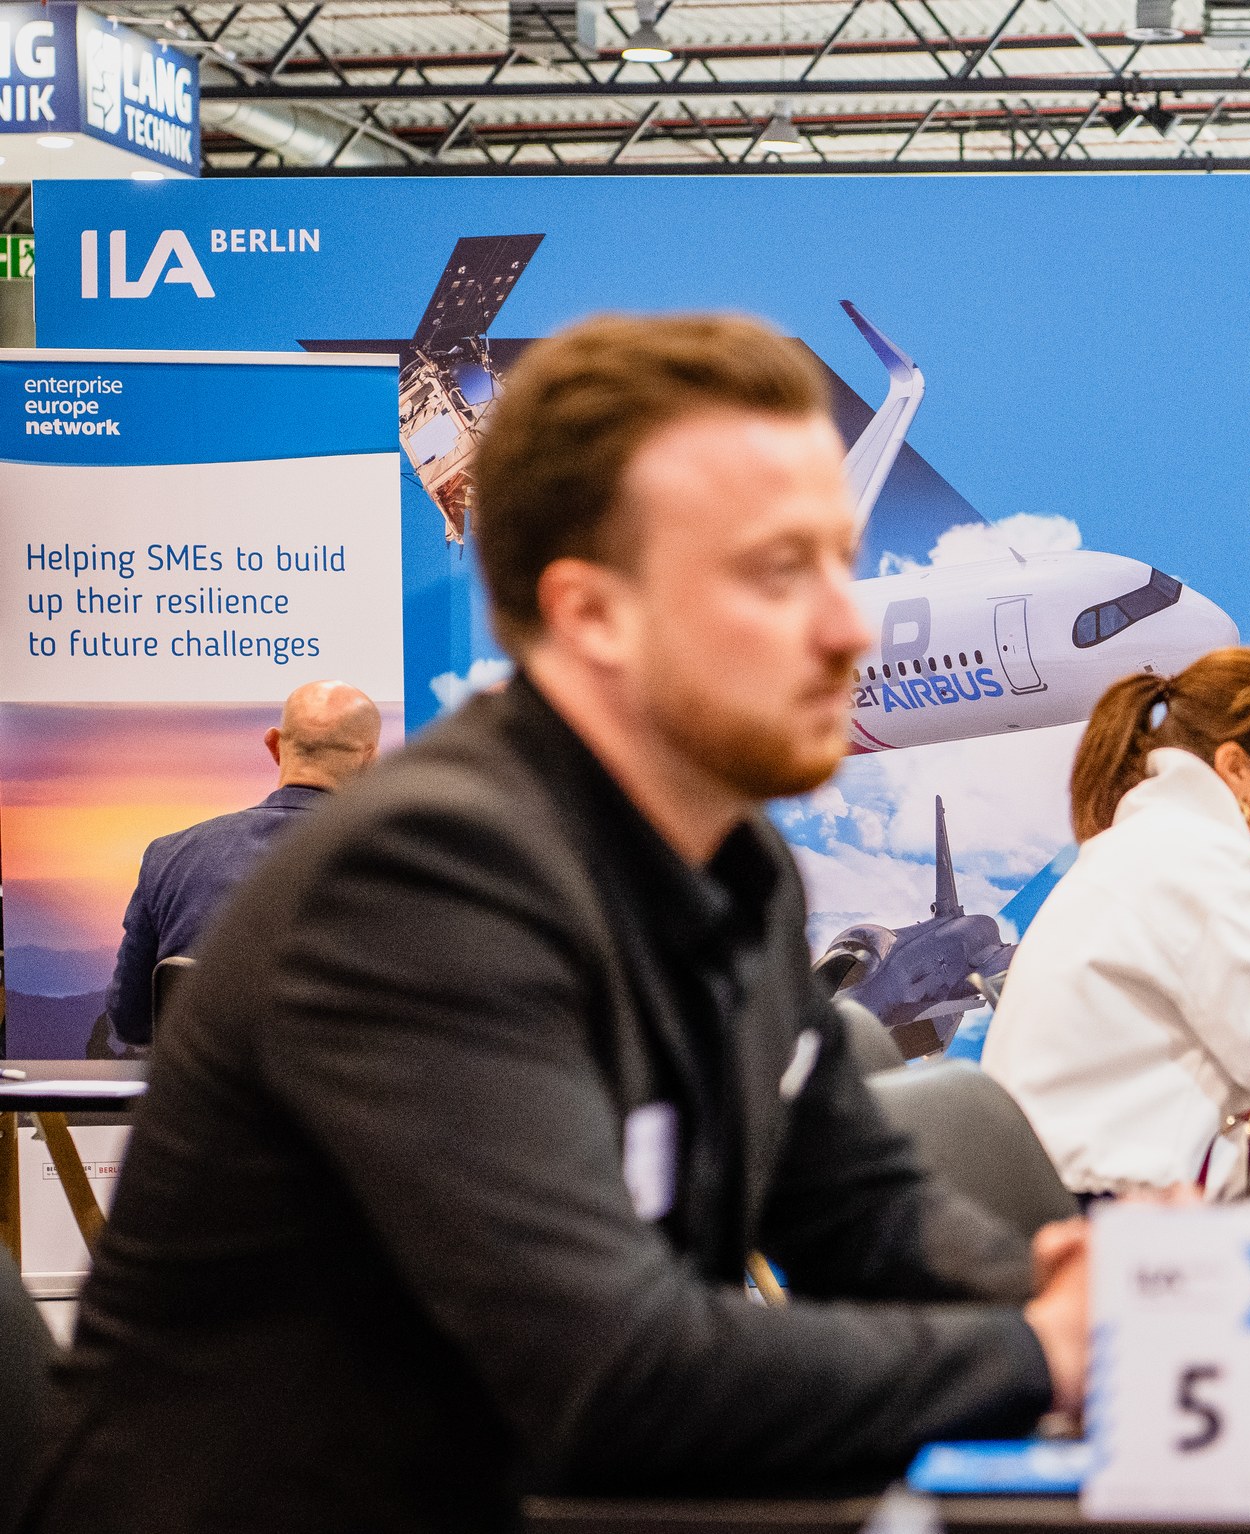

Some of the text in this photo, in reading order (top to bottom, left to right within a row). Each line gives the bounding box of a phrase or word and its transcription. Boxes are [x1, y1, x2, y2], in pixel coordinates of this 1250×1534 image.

[122, 42, 193, 124] LANG
[124, 104, 193, 165] TECHNIK
[81, 228, 320, 299] ILA BERLIN
[25, 376, 123, 397] enterprise
[25, 400, 99, 418] europe
[25, 418, 121, 436] network
[27, 543, 346, 579] Helping SMEs to build
[28, 587, 289, 620] up their resilience
[29, 630, 320, 665] to future challenges
[881, 668, 1004, 713] AIRBUS
[1174, 1361, 1223, 1453] 5
